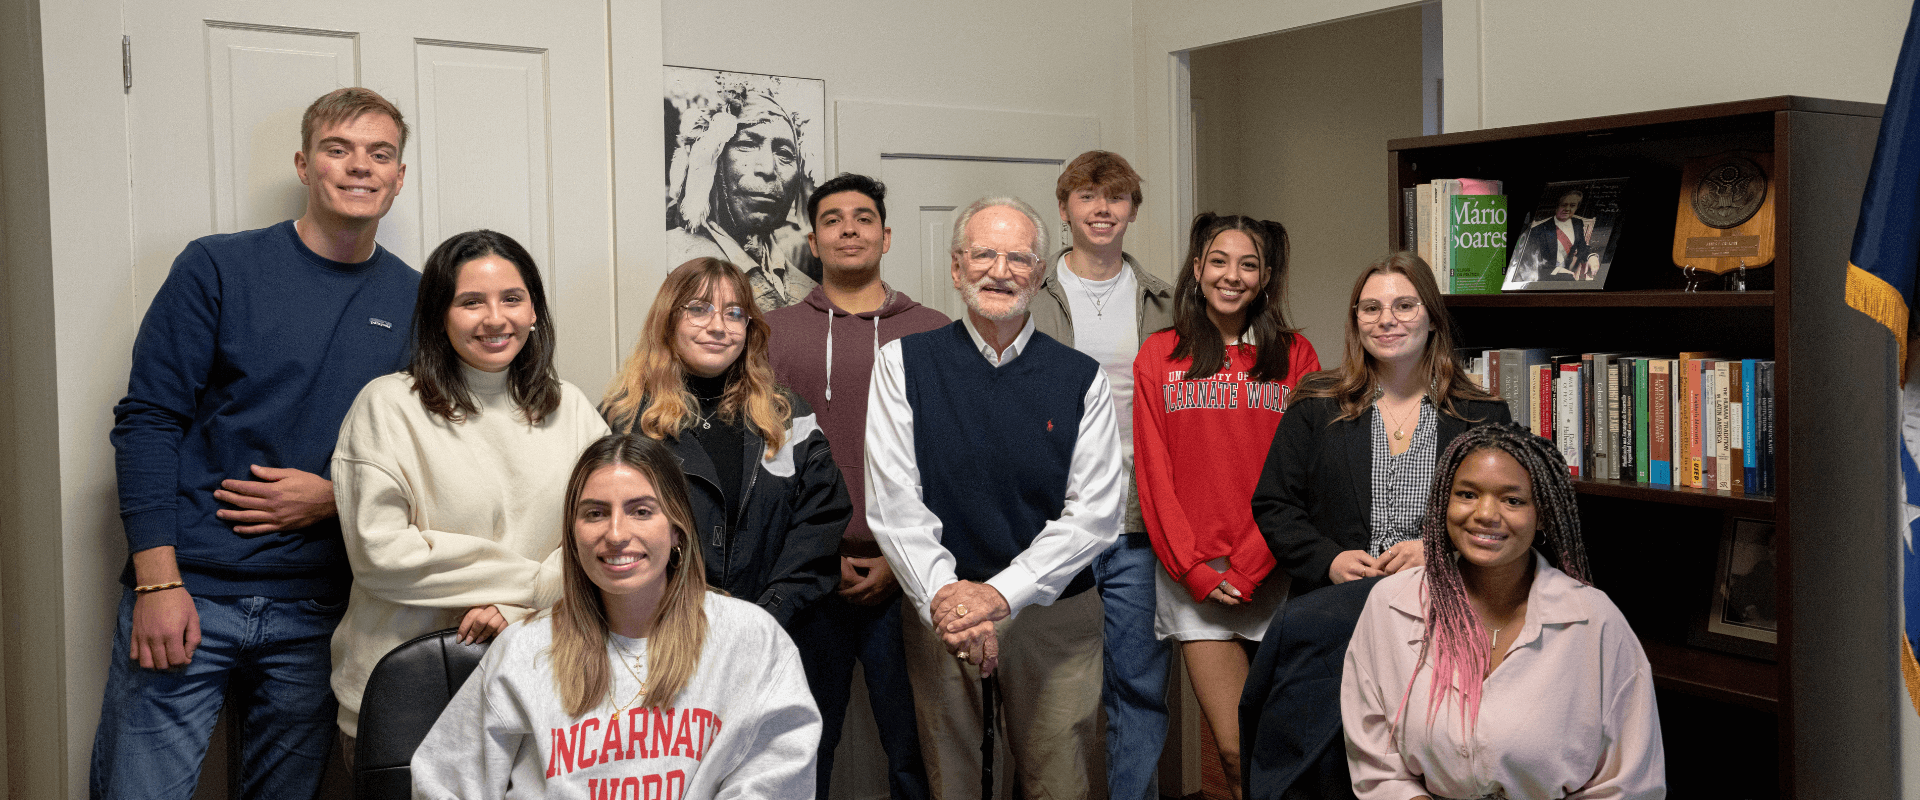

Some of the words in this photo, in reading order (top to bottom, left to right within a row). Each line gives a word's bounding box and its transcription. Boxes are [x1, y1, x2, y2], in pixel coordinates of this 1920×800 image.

[1454, 200, 1507, 225] Mário
[1454, 225, 1507, 249] Soares
[1722, 421, 1730, 452] TRADITION
[587, 769, 686, 800] WORD
